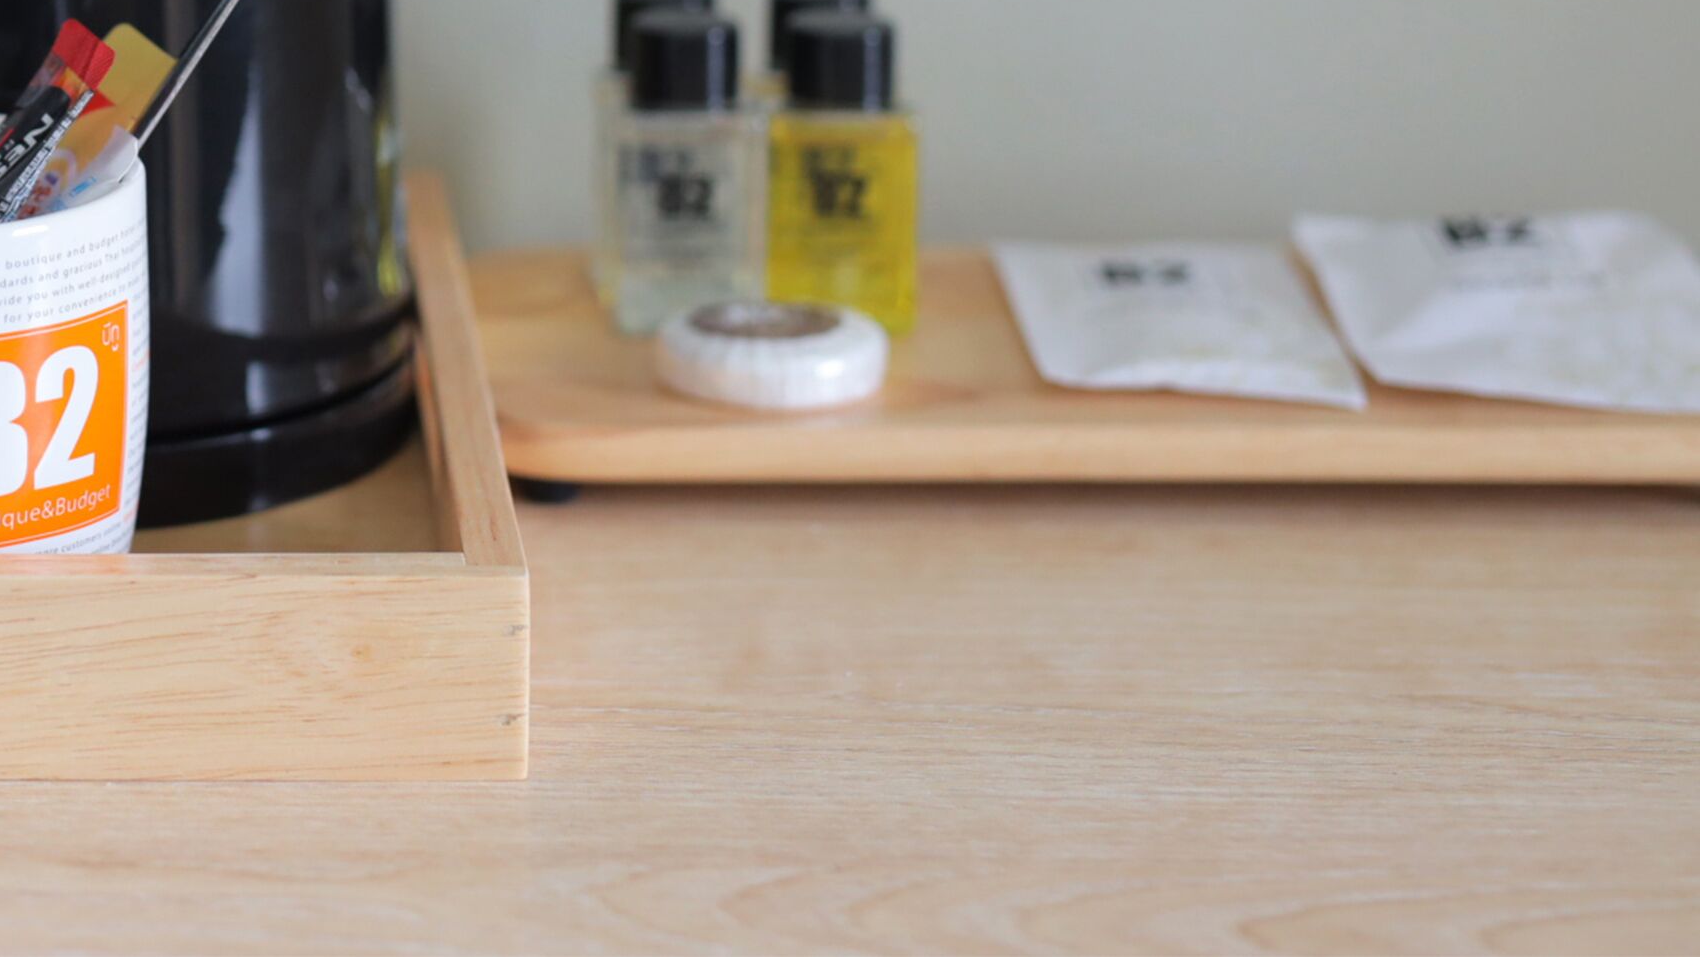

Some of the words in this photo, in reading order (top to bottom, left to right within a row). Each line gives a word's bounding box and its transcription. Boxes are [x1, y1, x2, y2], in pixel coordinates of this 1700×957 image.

[4, 252, 62, 270] boutique
[66, 243, 85, 258] and
[38, 268, 59, 282] and
[26, 291, 48, 305] you
[51, 283, 75, 297] with
[3, 313, 22, 325] for
[26, 307, 54, 322] your
